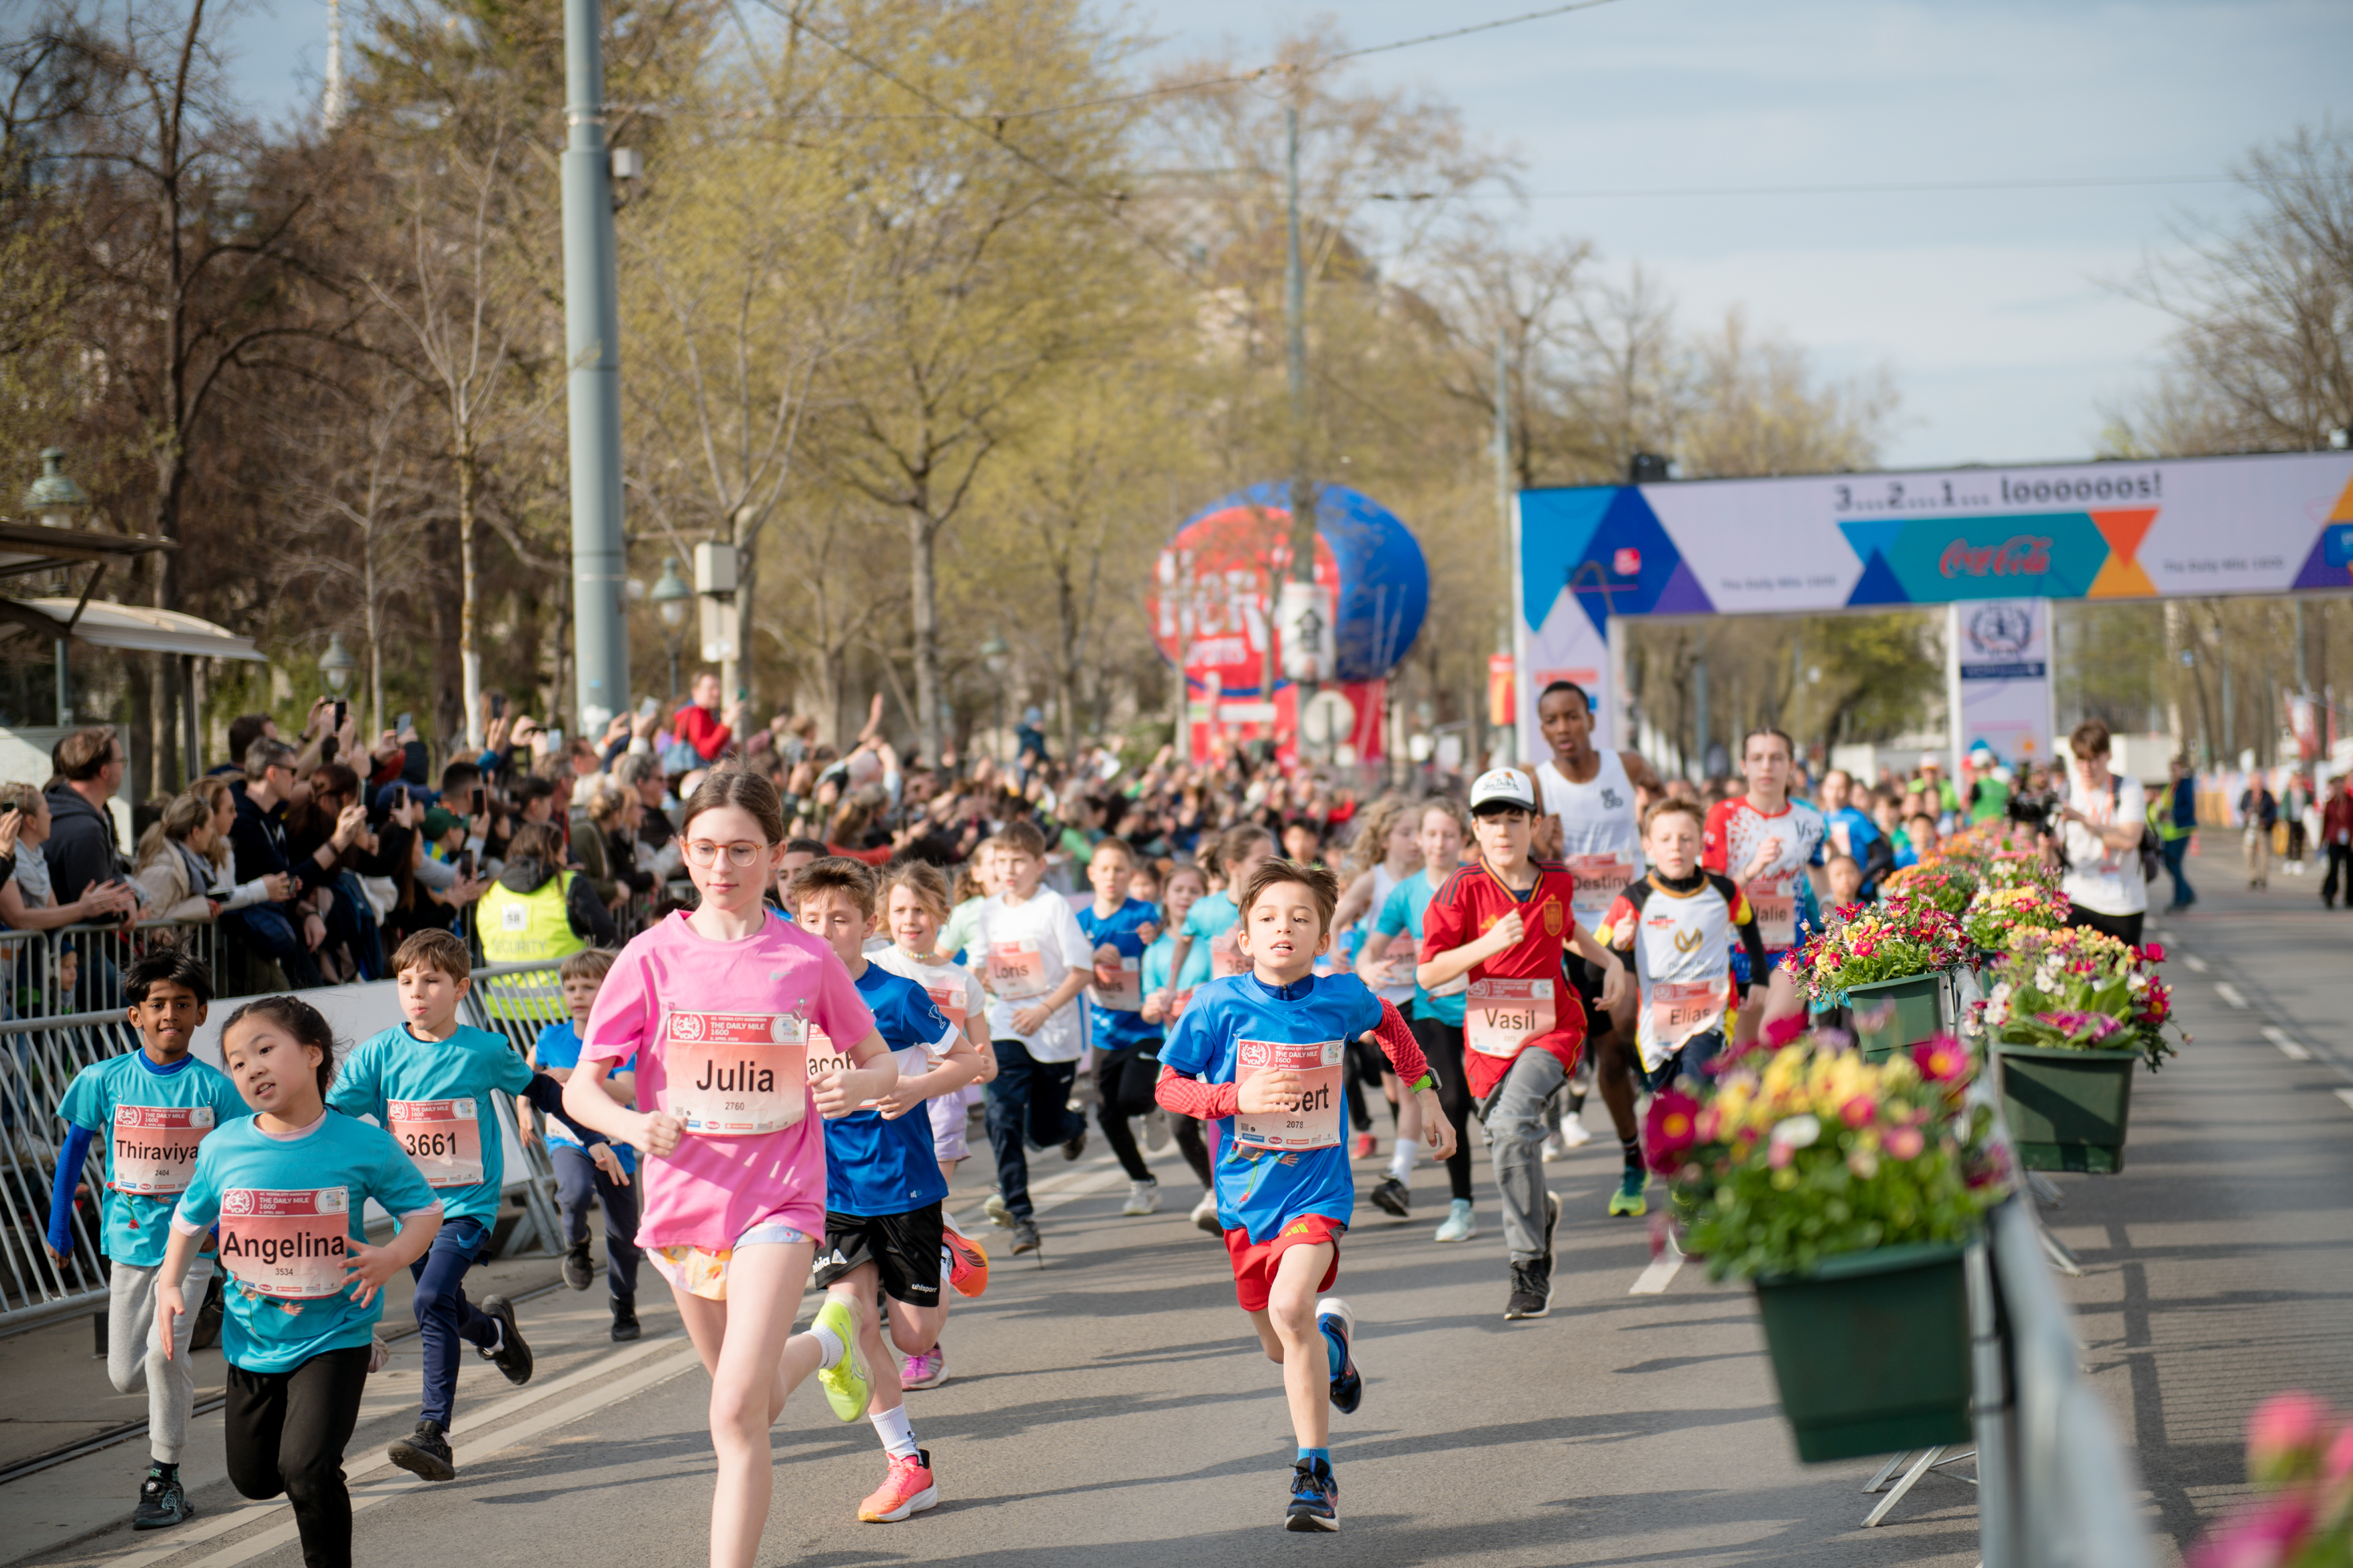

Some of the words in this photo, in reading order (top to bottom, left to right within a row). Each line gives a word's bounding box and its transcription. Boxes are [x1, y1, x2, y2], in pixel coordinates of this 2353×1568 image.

[492, 939, 547, 954] SECURITY
[994, 962, 1029, 979] Loris
[1484, 1008, 1535, 1030] Vasil
[1671, 1007, 1711, 1026] Elias
[696, 1060, 774, 1092] Julia
[725, 1102, 744, 1110] 2760
[116, 1140, 198, 1165] Thiraviya
[406, 1132, 456, 1156] 3661
[223, 1231, 345, 1265] Angelina
[912, 1284, 937, 1293] uhlsport
